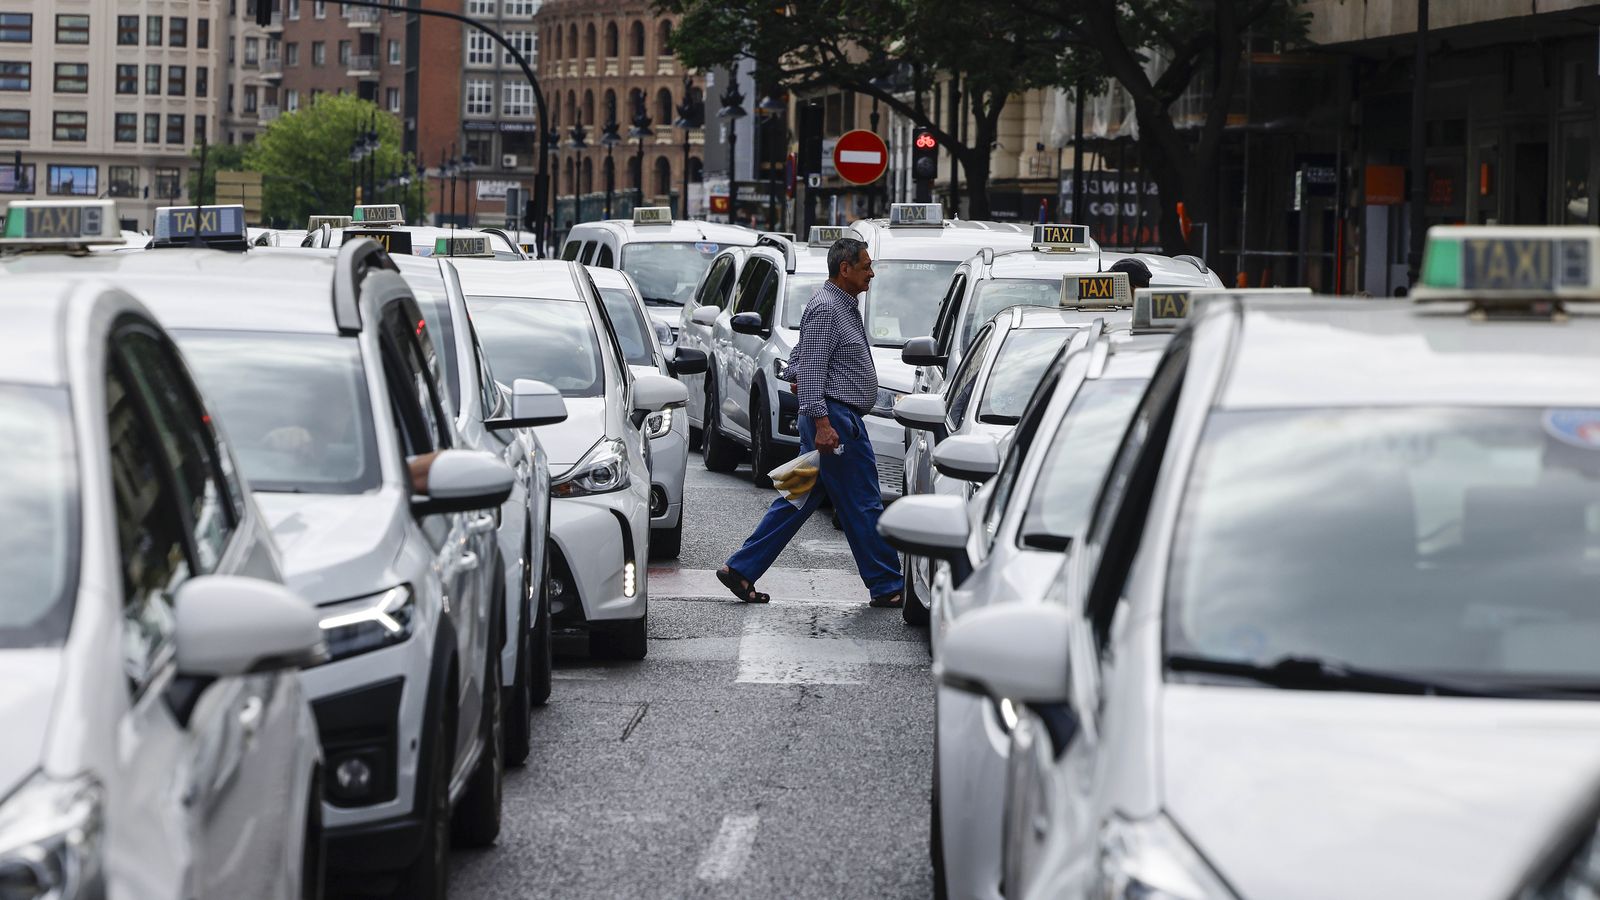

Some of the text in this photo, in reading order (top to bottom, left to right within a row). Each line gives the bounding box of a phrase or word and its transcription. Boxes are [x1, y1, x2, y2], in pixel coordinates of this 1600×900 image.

[365, 207, 387, 220] TAXI
[641, 209, 660, 219] TAXI
[901, 206, 927, 220] TAXI
[30, 208, 78, 236] TAXI
[173, 211, 216, 233] TAXI
[820, 228, 842, 239] TAXI
[1045, 227, 1073, 242] TAXI
[1470, 239, 1548, 286] TAXI
[1080, 279, 1113, 298] TAXI
[1152, 294, 1190, 318] TAX
